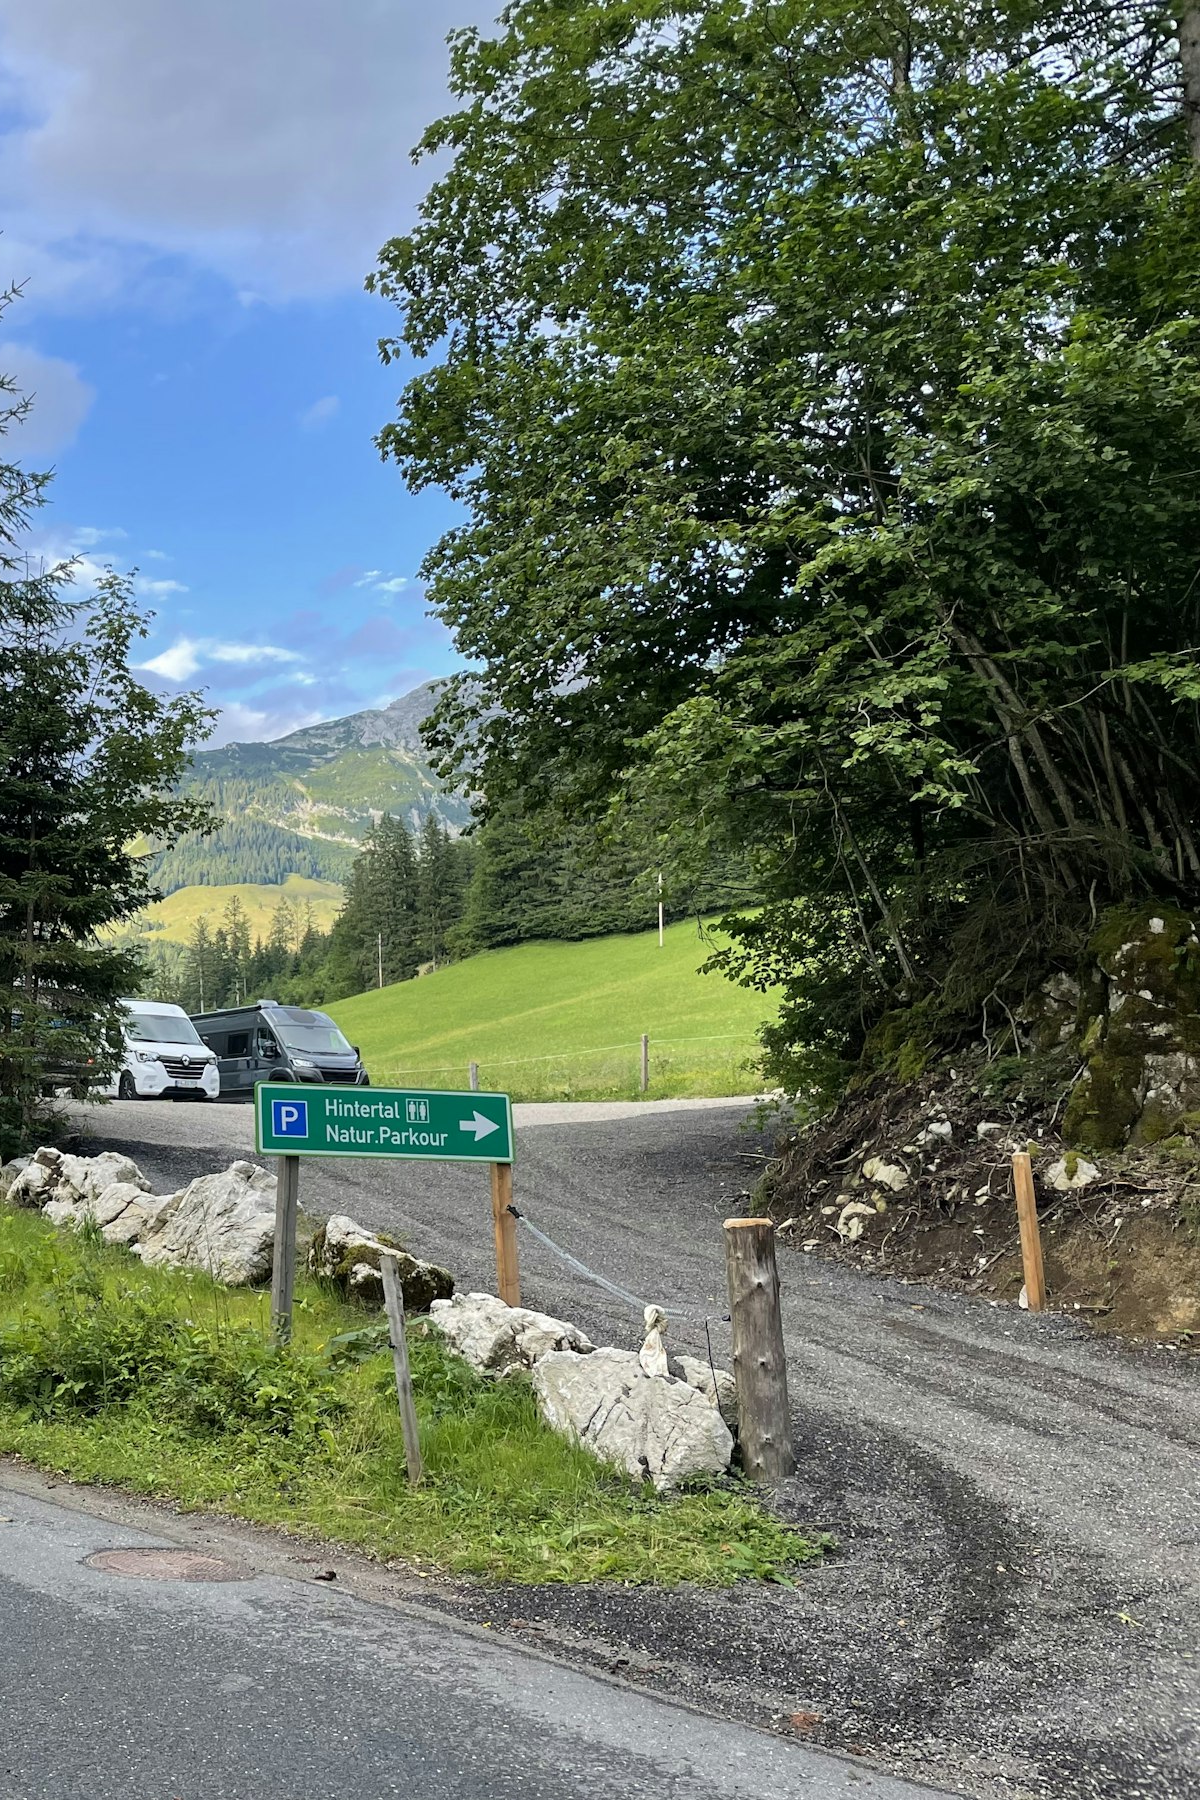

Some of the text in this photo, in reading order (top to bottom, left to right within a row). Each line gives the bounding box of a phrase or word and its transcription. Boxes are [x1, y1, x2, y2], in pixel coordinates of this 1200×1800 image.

[281, 1106, 299, 1131] P
[325, 1098, 400, 1119] Hintertal
[326, 1124, 448, 1146] Natur.Parkour
